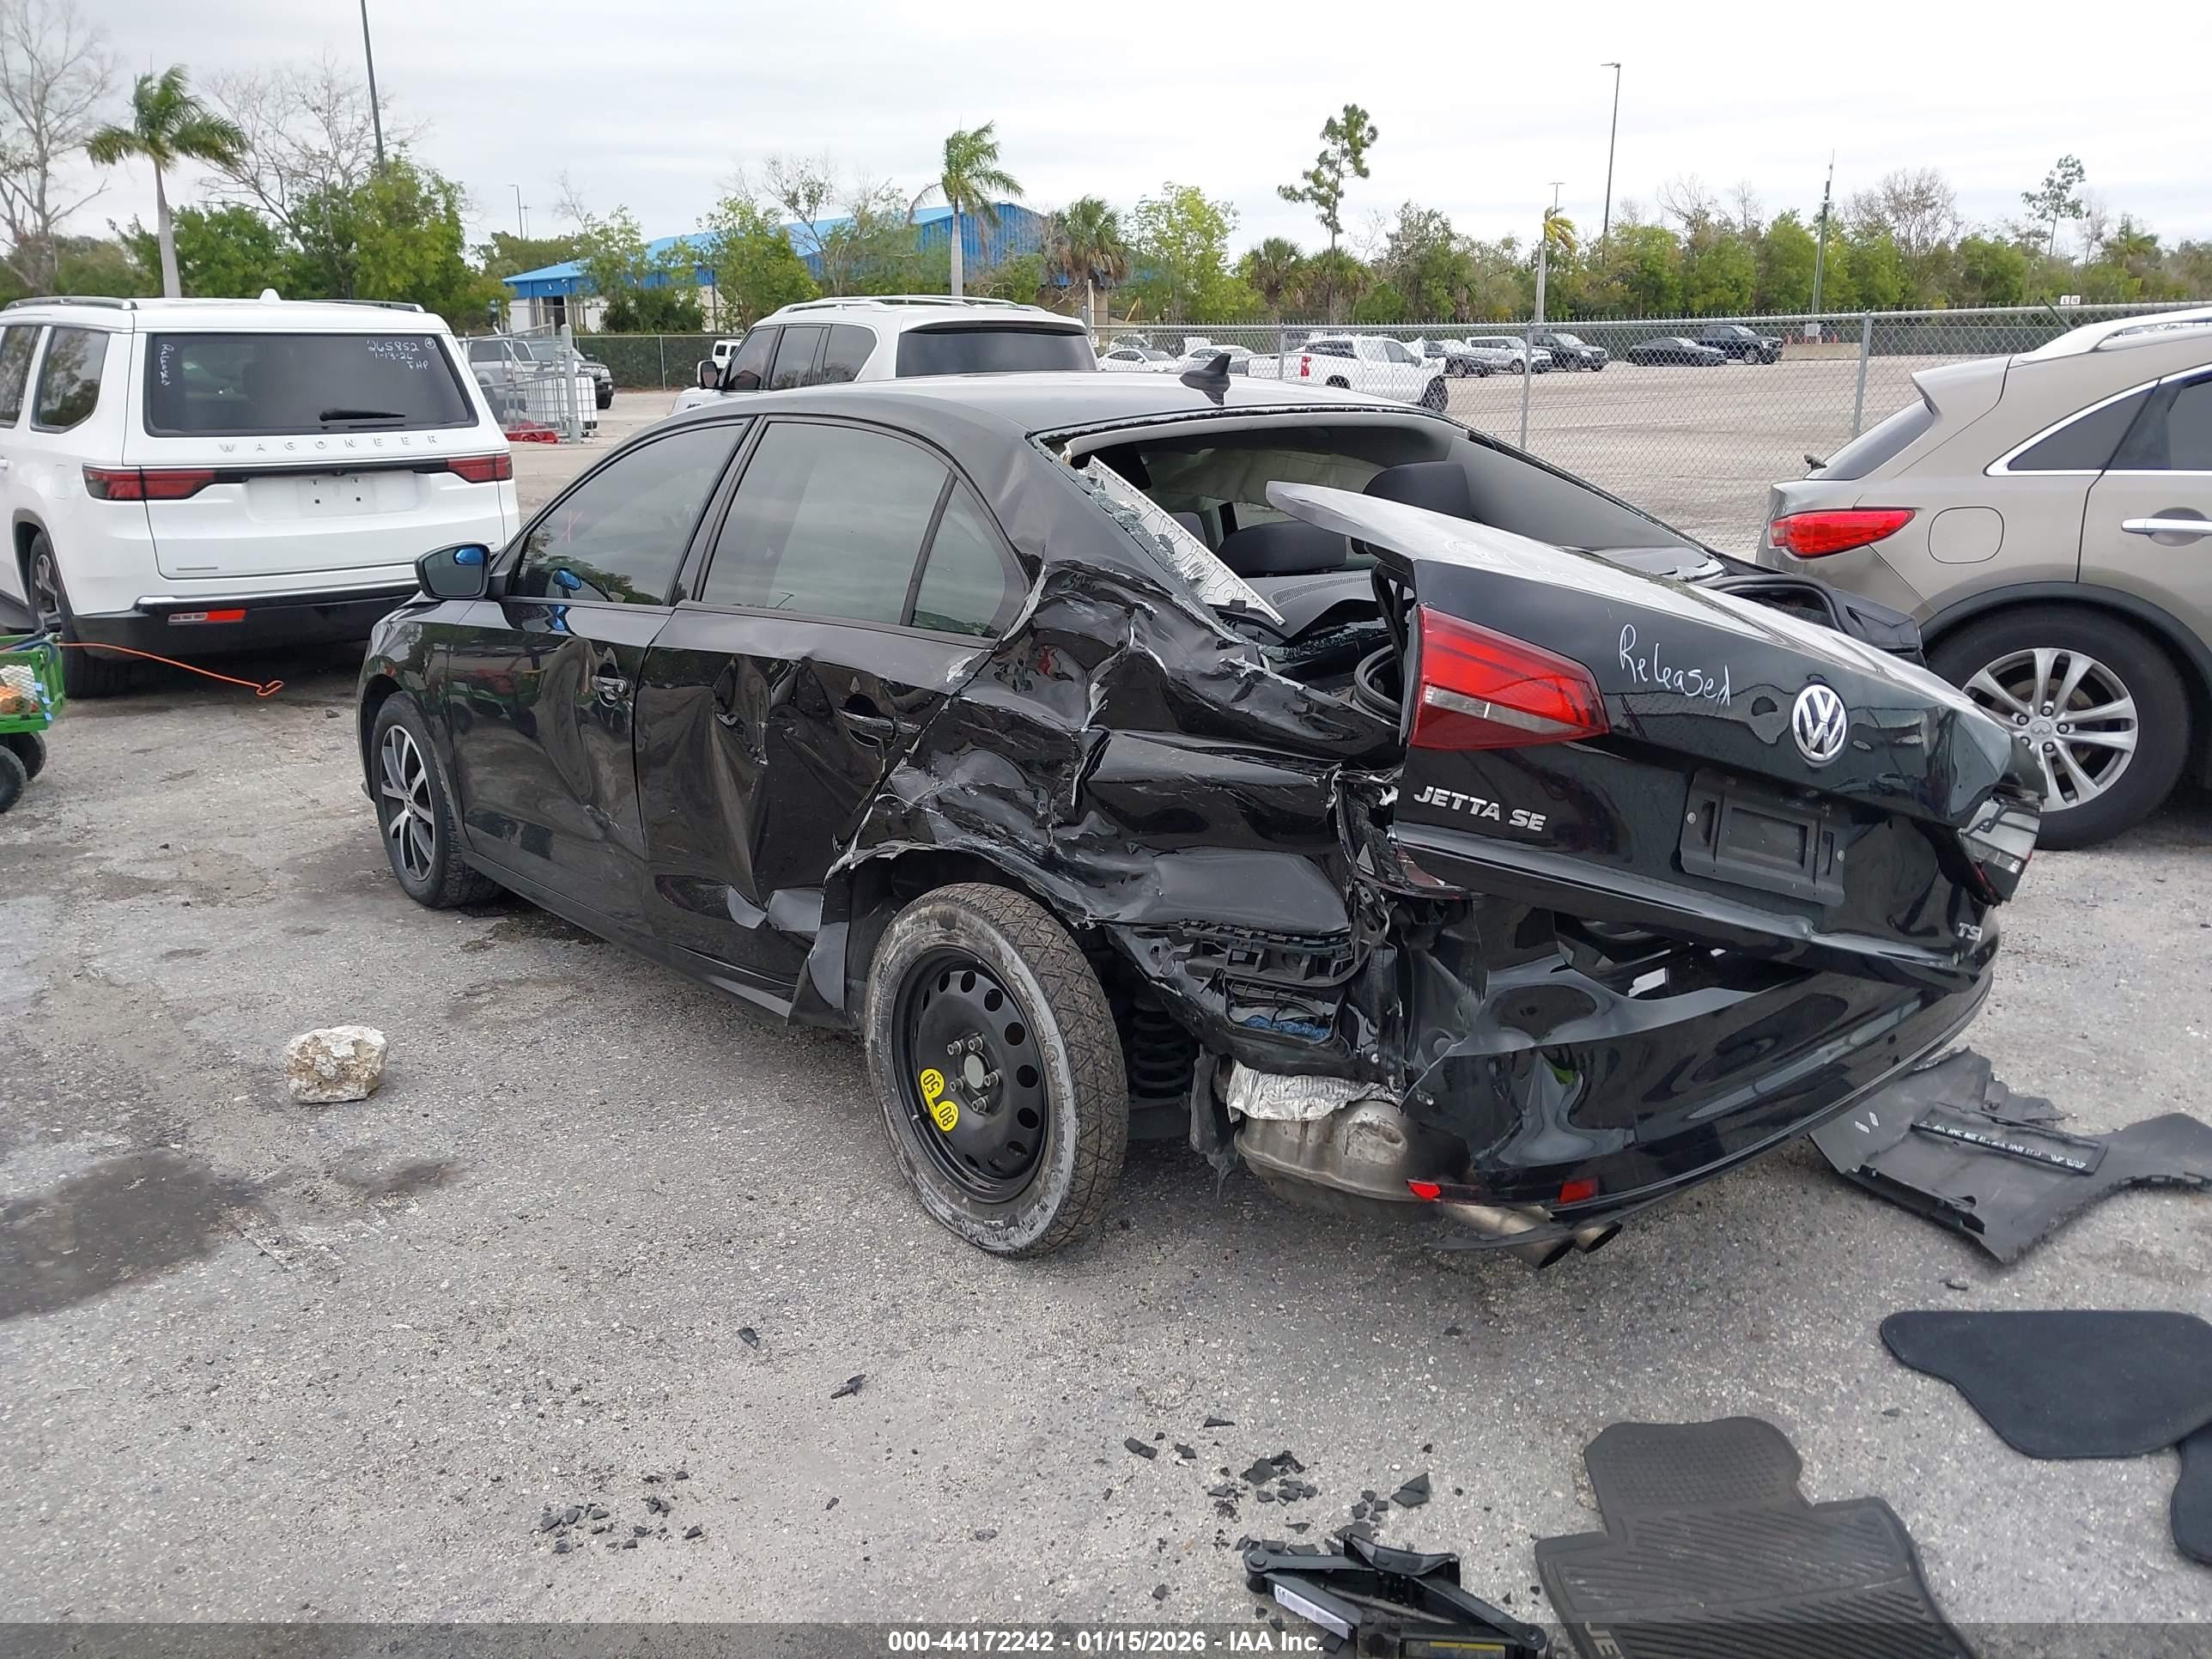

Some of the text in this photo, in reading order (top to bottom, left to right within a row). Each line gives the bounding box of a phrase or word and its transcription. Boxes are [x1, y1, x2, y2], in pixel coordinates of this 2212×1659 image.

[219, 434, 438, 453] WAGONEER
[1619, 623, 1731, 707] Released
[1413, 786, 1547, 831] JETTA SE
[1958, 921, 1983, 942] TSI
[923, 1073, 940, 1094] 50
[939, 1106, 955, 1127] 80
